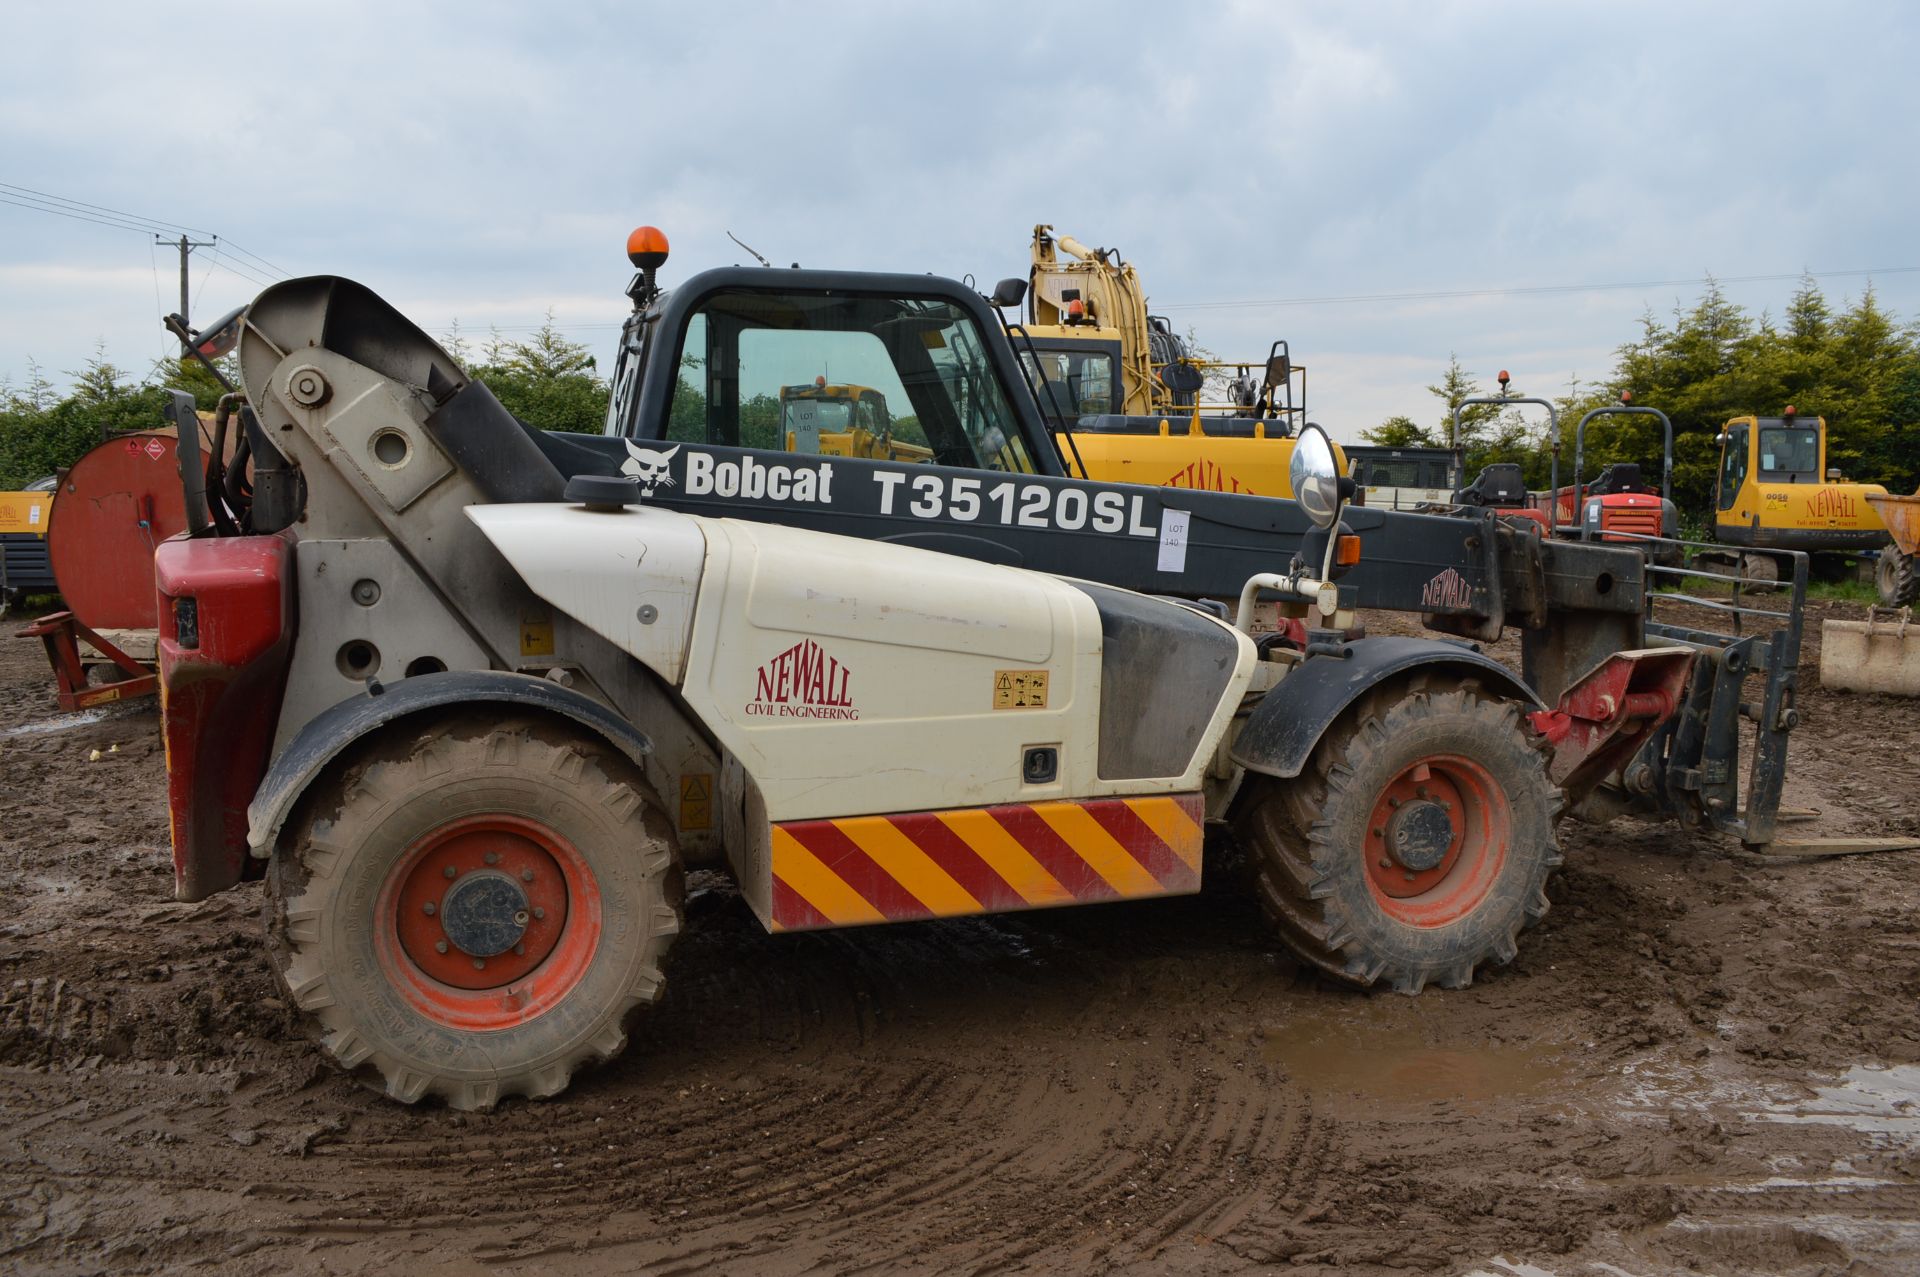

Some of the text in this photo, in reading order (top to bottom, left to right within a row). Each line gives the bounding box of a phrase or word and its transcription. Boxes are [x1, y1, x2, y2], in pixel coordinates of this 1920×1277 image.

[800, 412, 813, 420] LOT
[685, 451, 833, 504] Bobcat
[873, 470, 1157, 537] T35120SL
[1805, 487, 1858, 518] NEWALL
[1169, 525, 1185, 533] LOT
[1164, 538, 1179, 546] 140
[1421, 566, 1472, 609] NEWALL
[754, 638, 852, 707] NEWALL
[745, 703, 859, 721] CIVIL ENGINEERING
